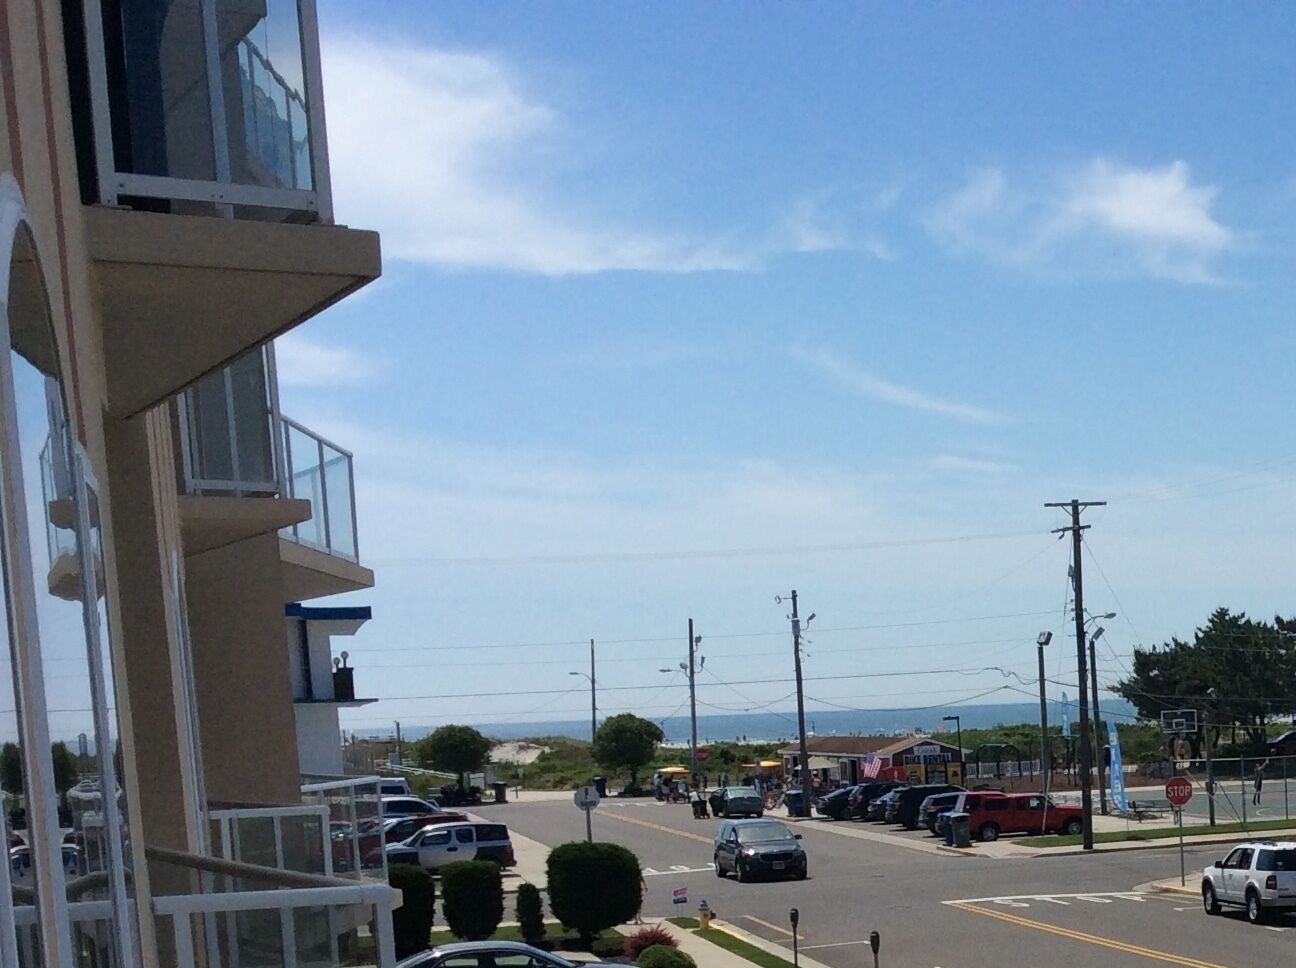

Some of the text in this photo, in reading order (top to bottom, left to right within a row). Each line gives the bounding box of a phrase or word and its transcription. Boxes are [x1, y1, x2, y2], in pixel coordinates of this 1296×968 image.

[904, 753, 952, 765] BIKE RENTAL
[1167, 785, 1191, 798] STOP
[993, 894, 1147, 907] STOP
